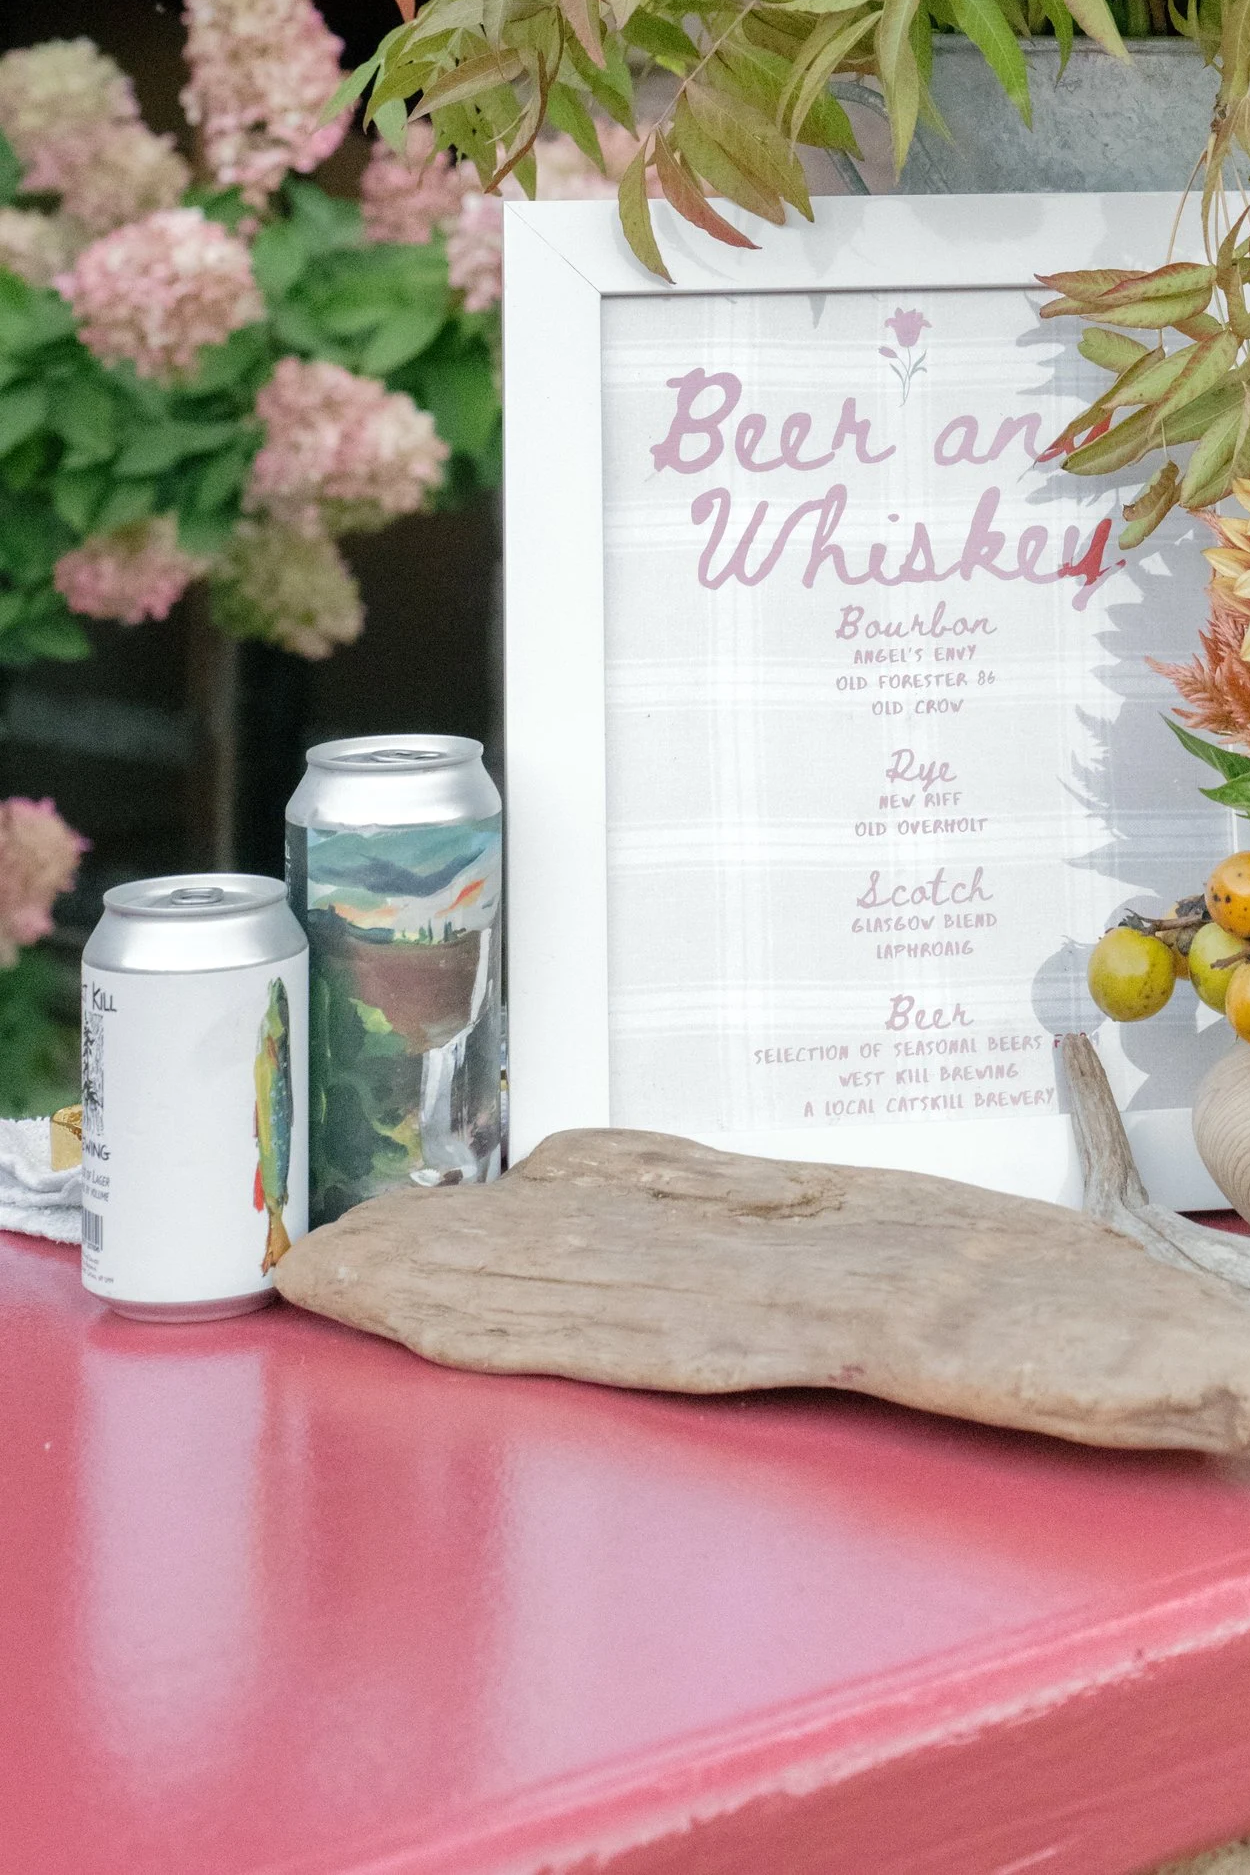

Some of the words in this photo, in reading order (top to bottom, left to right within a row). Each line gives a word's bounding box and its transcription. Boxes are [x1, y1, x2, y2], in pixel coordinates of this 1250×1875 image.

[650, 368, 896, 474] Beer
[691, 484, 1127, 611] Whiskey
[835, 600, 998, 640] Bourbon
[854, 648, 923, 665] ANGEL'S
[934, 644, 977, 662] ENVY
[836, 675, 868, 691] OLD
[879, 672, 968, 689] FORESTER
[977, 670, 996, 686] 86
[872, 701, 903, 716] OLD
[915, 698, 965, 715] CROW
[886, 748, 958, 793] Rye
[879, 794, 916, 810] NEW
[924, 792, 963, 808] RIFF
[854, 822, 888, 837] OLD
[897, 818, 989, 835] OVERHOLT
[856, 866, 994, 910] Scotch
[851, 915, 936, 933] GLASGOW
[944, 913, 998, 929] BLEND
[876, 940, 974, 960] LAPHROAIG
[92, 981, 118, 1013] KILL
[884, 993, 975, 1032] Beer
[753, 1045, 850, 1065] SELECTION
[859, 1042, 883, 1059] OF
[893, 1037, 977, 1058] SEASONAL
[987, 1035, 1043, 1052] BEERS
[839, 1071, 886, 1088] WEST
[896, 1068, 929, 1085] KILL
[940, 1063, 1020, 1082] BREWING
[804, 1101, 814, 1118] A
[825, 1098, 875, 1116] LOCAL
[886, 1093, 964, 1113] CATSKILL
[974, 1088, 1055, 1108] BREWERY
